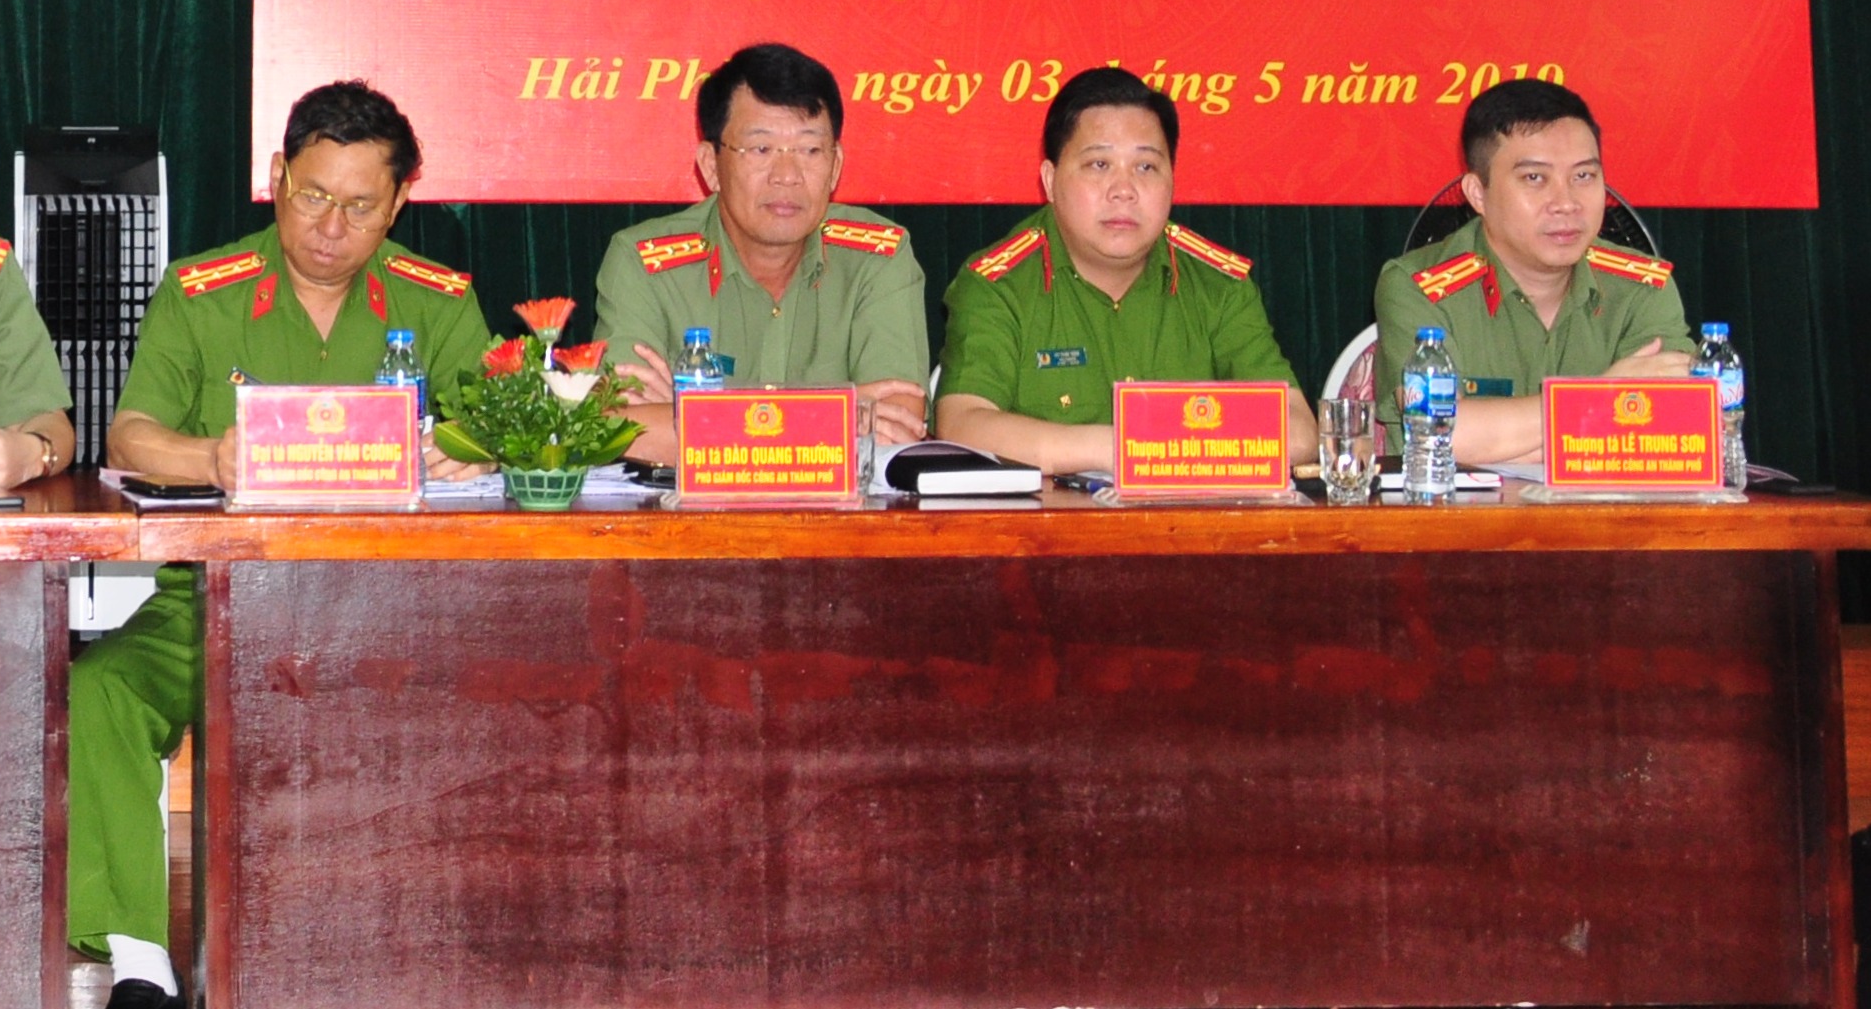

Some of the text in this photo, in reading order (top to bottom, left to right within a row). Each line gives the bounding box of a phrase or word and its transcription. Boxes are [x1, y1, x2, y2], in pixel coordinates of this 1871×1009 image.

[522, 58, 622, 99] Hải
[852, 60, 982, 113] ngày
[1002, 60, 1062, 101] 03
[1097, 60, 1236, 114] áng
[1255, 62, 1284, 103] 5
[1302, 64, 1417, 103] năm
[686, 447, 706, 469] Đại
[708, 447, 721, 465] tá
[724, 443, 748, 465] ĐÀO
[751, 446, 792, 466] QUANG
[1126, 439, 1166, 462] Thượng
[1182, 436, 1201, 458] BÙI
[1204, 439, 1240, 458] TRUNG
[1242, 436, 1279, 458] THÀNH
[1562, 434, 1604, 456] Thượng
[1621, 432, 1636, 453] LÊ
[1638, 435, 1677, 454] TRUNG
[1680, 434, 1706, 454] SƠN
